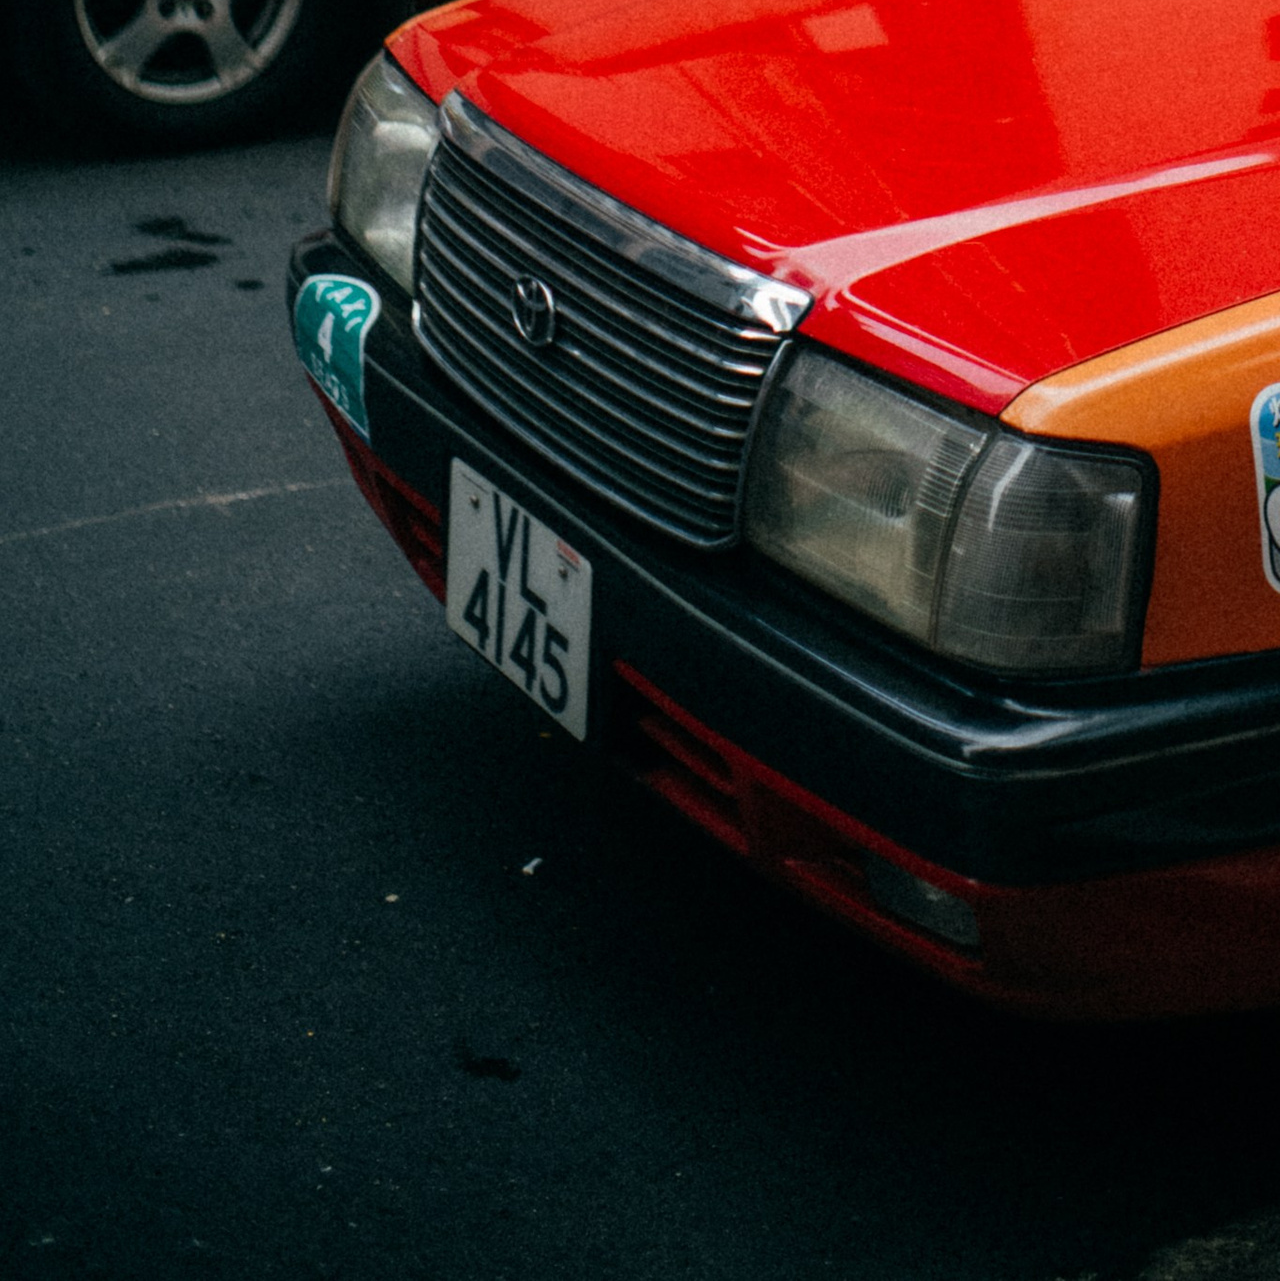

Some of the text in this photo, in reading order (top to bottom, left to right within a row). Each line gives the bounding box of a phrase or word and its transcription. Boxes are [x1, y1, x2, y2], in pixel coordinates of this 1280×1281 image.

[314, 281, 367, 333] TAXI
[317, 310, 335, 364] 4
[492, 490, 548, 614] VL
[463, 568, 570, 715] 4145
